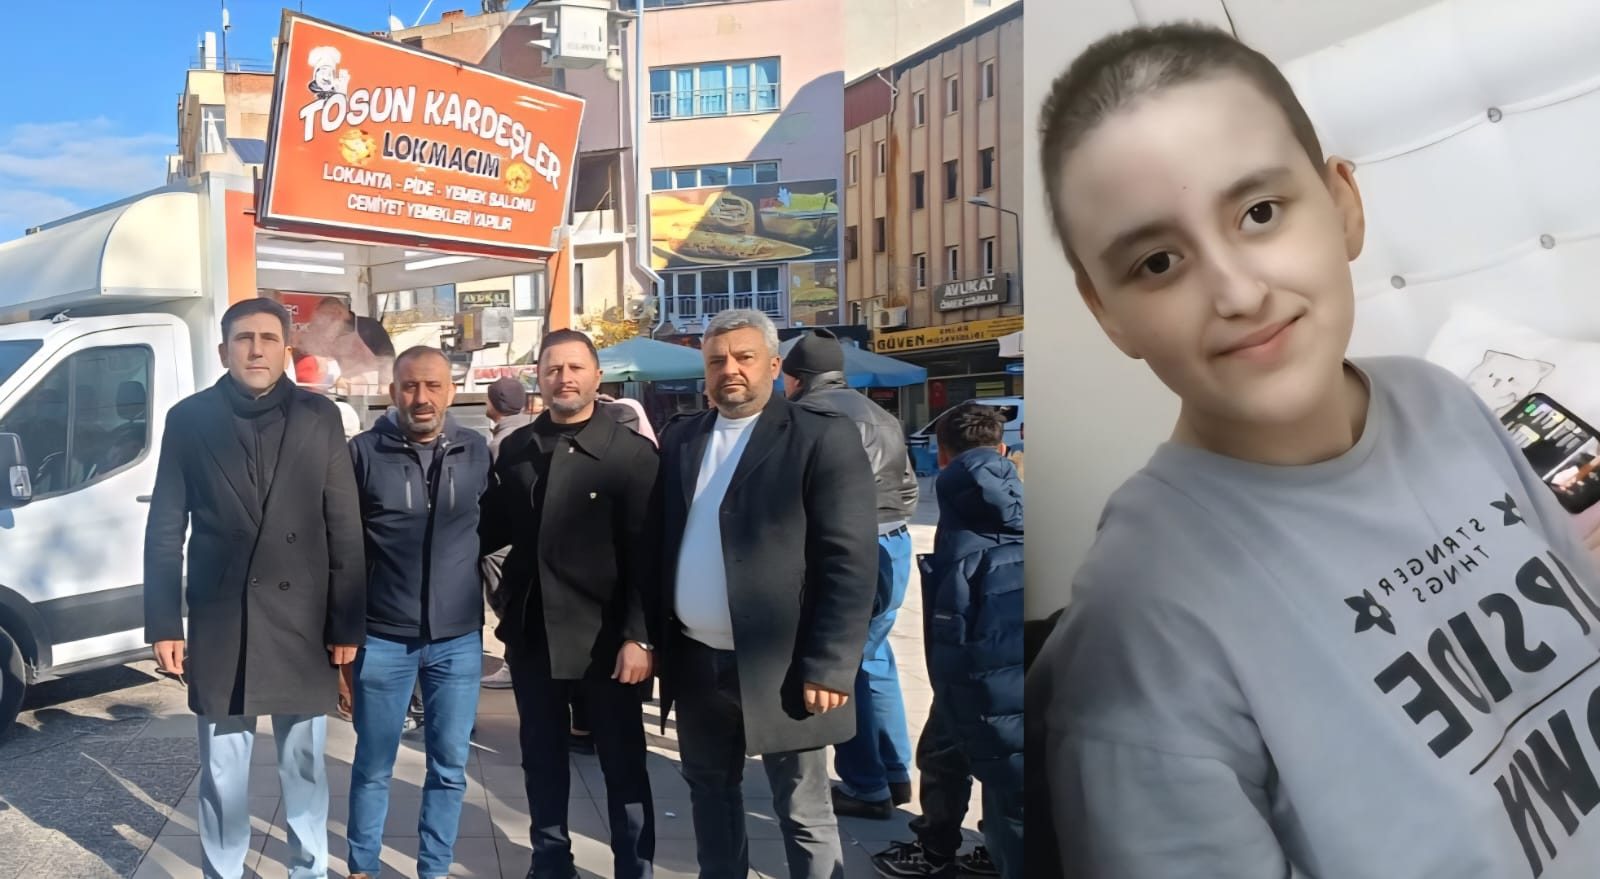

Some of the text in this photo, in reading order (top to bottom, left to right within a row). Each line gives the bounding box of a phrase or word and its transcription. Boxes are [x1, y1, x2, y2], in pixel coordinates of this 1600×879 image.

[299, 86, 559, 191] TOSUN KARDEŞLER
[383, 131, 500, 179] LOKMACIM
[323, 163, 392, 190] LOKANTA
[403, 175, 435, 196] PİDE
[445, 185, 486, 206] YEMEK
[488, 192, 536, 212] SALONU
[347, 193, 404, 216] CEMİYET
[877, 334, 925, 351] GÜVEN
